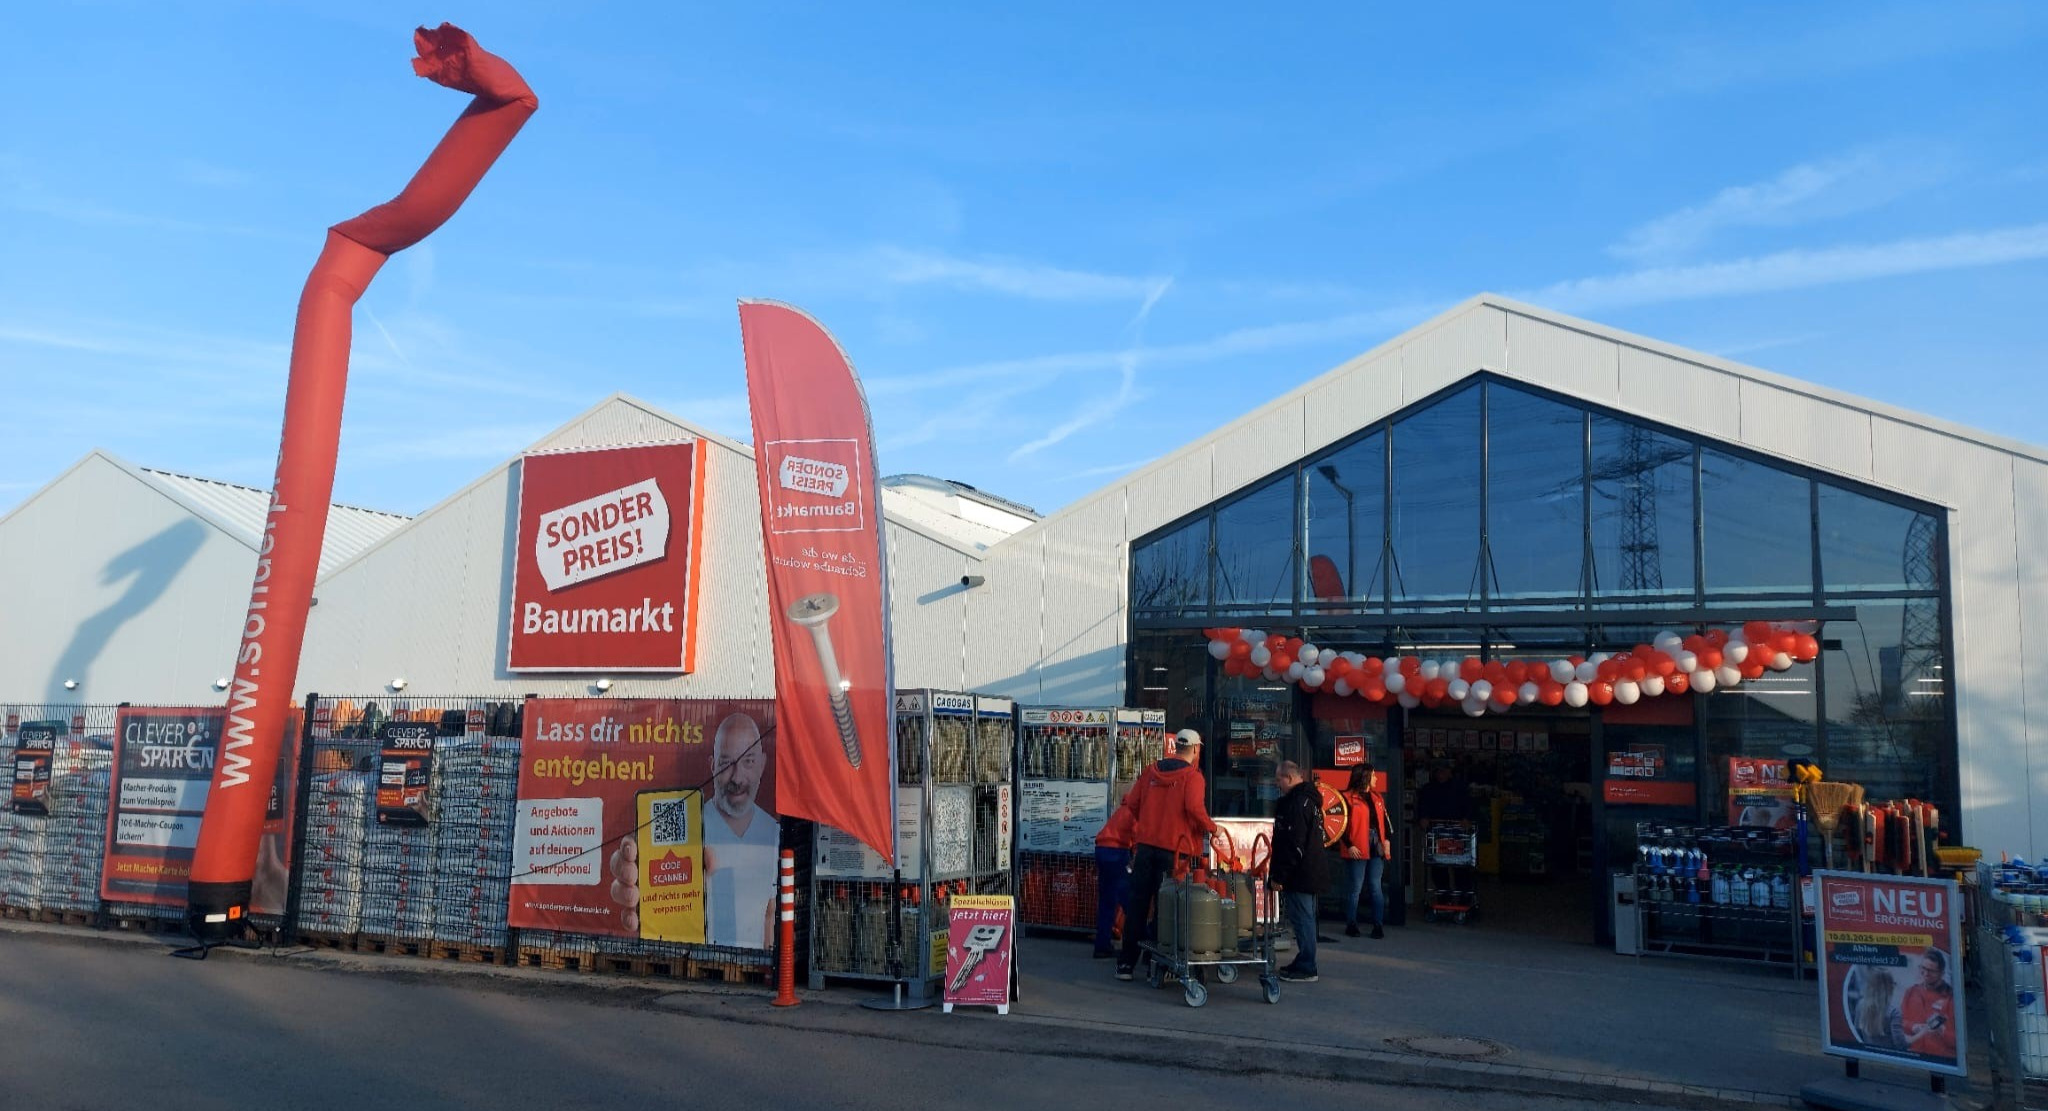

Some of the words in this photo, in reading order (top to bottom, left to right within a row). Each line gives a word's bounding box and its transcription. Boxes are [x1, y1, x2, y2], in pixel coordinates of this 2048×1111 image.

[546, 492, 653, 548] SONDER
[562, 528, 644, 576] PREIS!
[523, 598, 674, 634] Baumarkt
[126, 723, 185, 744] CLEVER
[388, 728, 416, 737] CLEVER
[536, 717, 585, 742] Lass
[591, 716, 624, 742] dir
[629, 717, 703, 744] nichts
[533, 753, 654, 786] entgehen!
[123, 783, 176, 793] Macher-Produkte
[122, 797, 136, 805] zum
[530, 806, 578, 820] Angebote
[530, 825, 549, 836] und
[551, 824, 595, 836] Aktionen
[529, 843, 545, 855] auf
[547, 843, 583, 855] deinem
[529, 863, 591, 876] Smartphone!
[660, 861, 681, 870] CODE
[653, 873, 688, 884] SCANNEN
[953, 897, 1010, 907] Spezialschlüssel
[1873, 887, 1943, 918] NEU
[953, 911, 978, 921] jetzt
[982, 910, 1009, 920] hier!
[1875, 914, 1944, 929] ERÖFFNUNG
[1853, 945, 1878, 953] Ahlen
